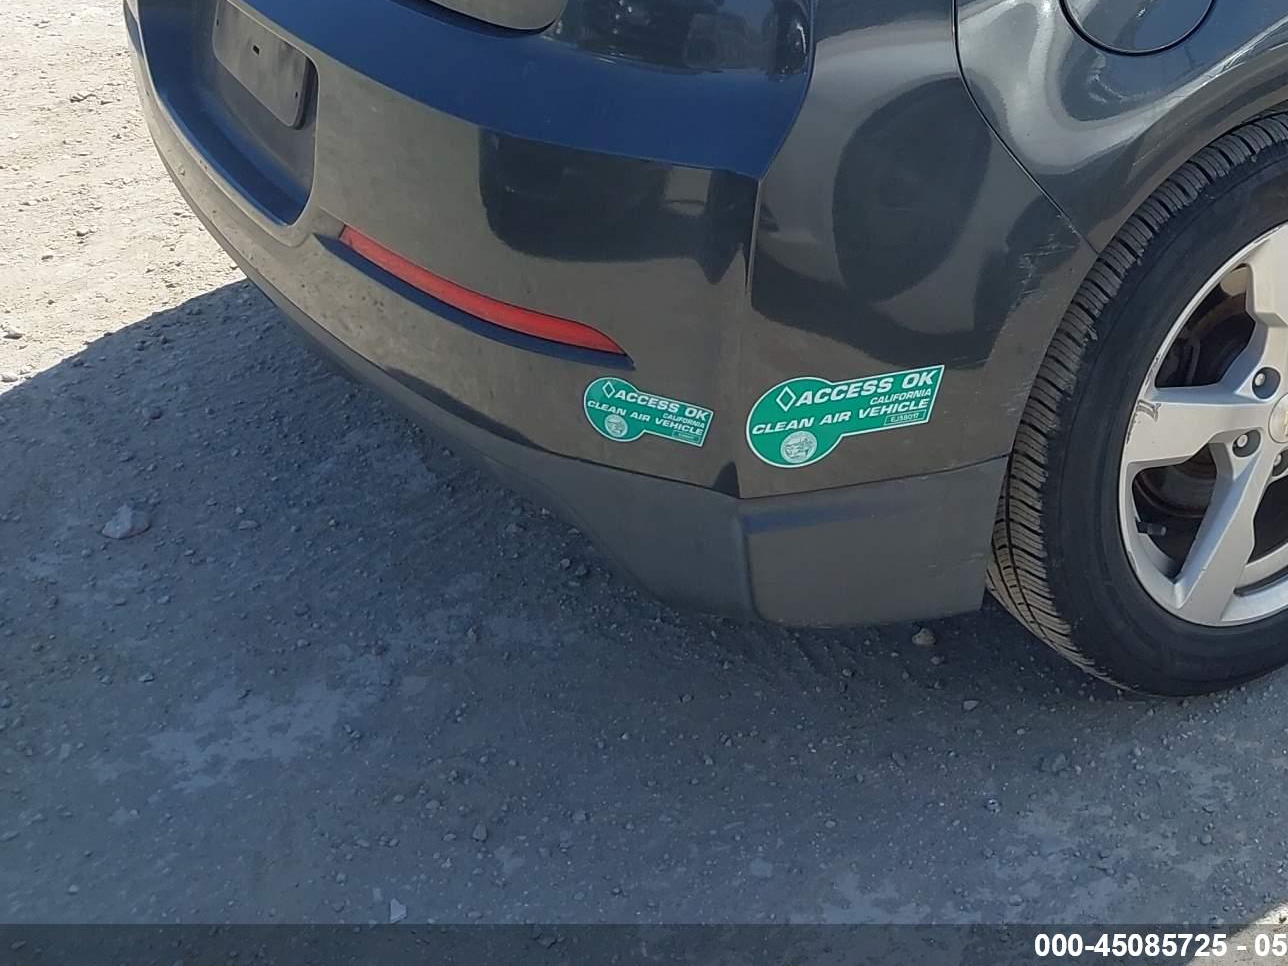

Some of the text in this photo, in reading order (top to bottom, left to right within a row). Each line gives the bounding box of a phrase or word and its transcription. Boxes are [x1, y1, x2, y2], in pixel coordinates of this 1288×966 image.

[614, 389, 709, 421] ACCESS OK
[795, 370, 938, 407] ACCESS OK
[869, 388, 932, 406] CALIFORNIA
[587, 400, 704, 435] CLEAN AIR VEHICLE
[662, 413, 705, 428] CALIFORNIA
[752, 398, 930, 435] CLEAN AIR VEHICLE
